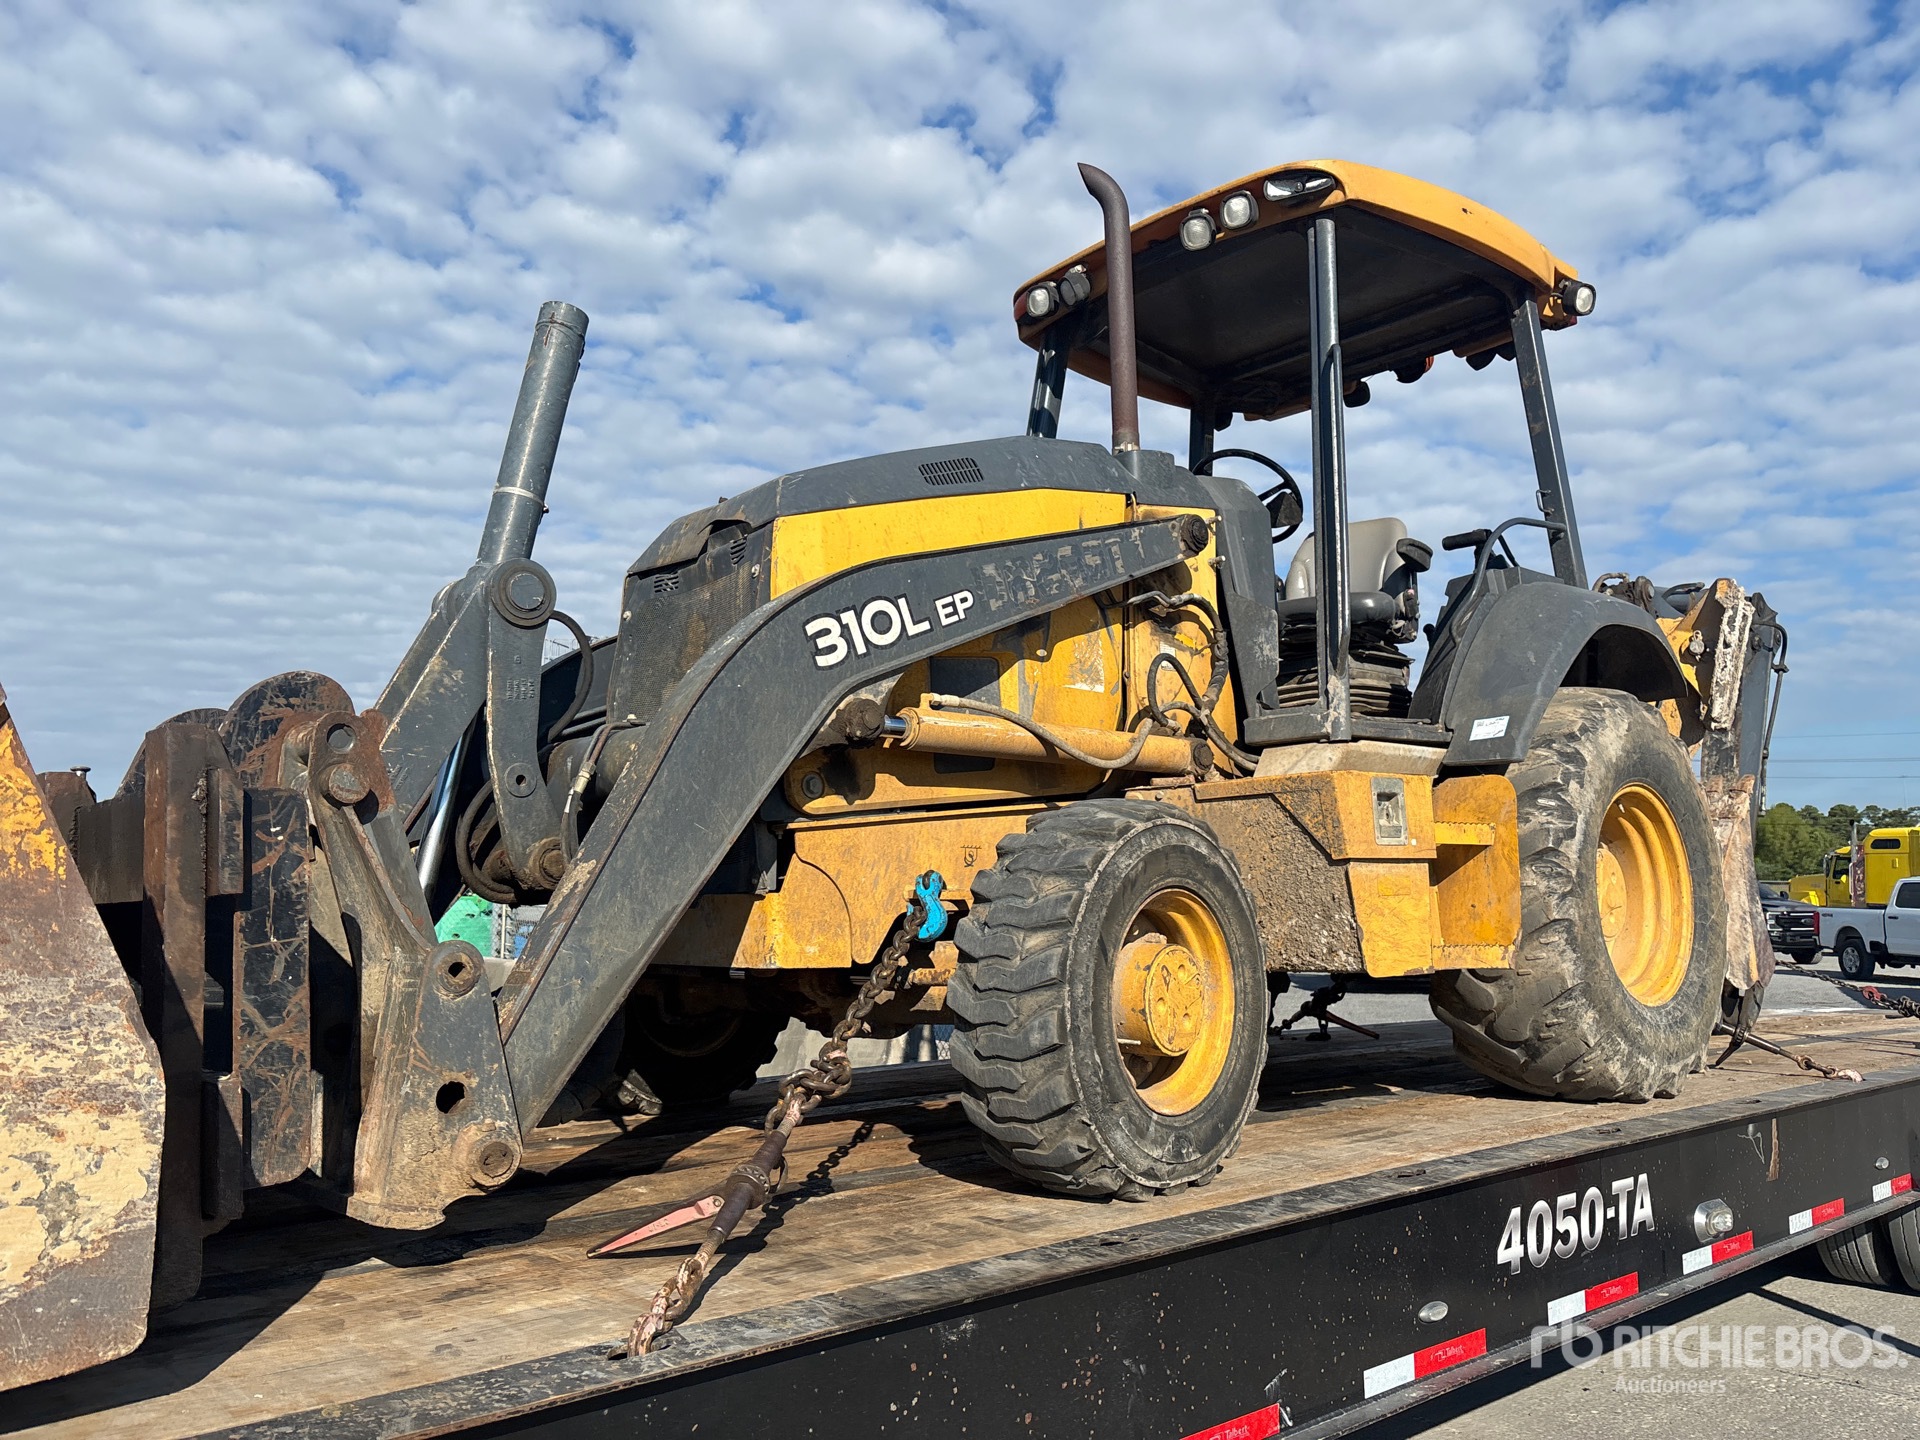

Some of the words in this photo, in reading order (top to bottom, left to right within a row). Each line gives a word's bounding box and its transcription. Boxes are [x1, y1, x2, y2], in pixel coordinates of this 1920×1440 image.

[804, 594, 932, 669] 310L
[935, 590, 975, 628] EP
[1496, 1172, 1655, 1276] 4050-TA
